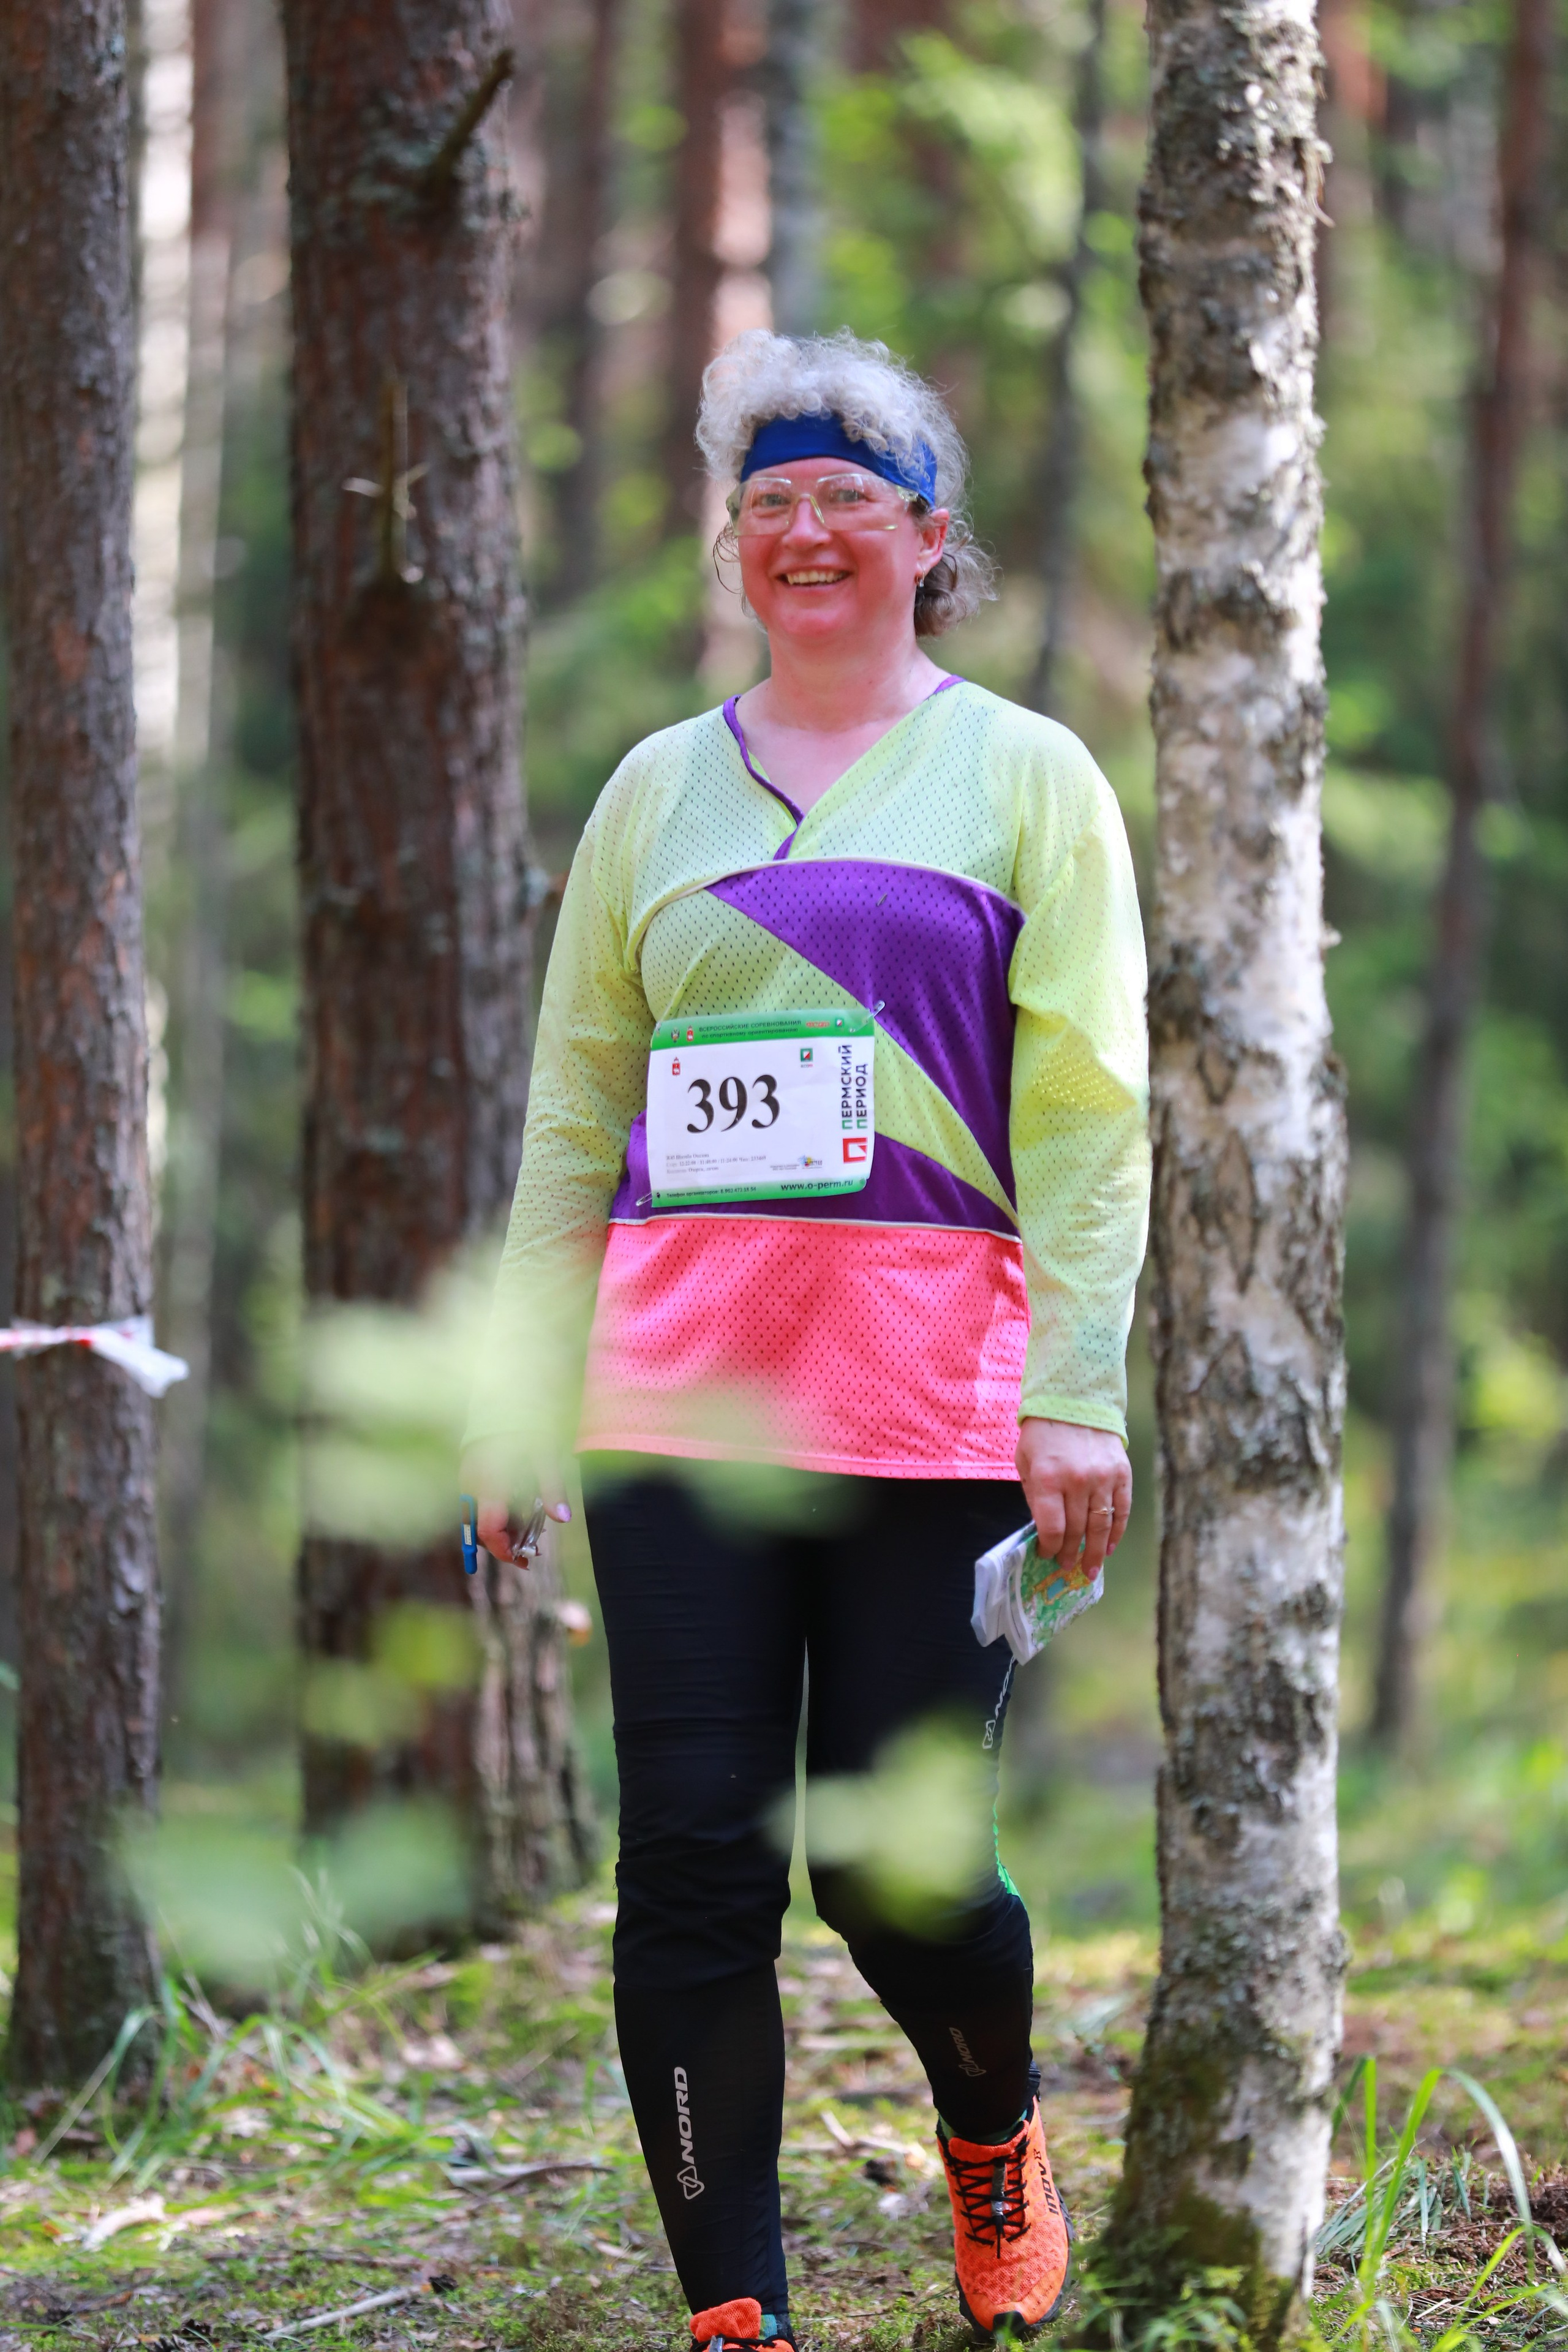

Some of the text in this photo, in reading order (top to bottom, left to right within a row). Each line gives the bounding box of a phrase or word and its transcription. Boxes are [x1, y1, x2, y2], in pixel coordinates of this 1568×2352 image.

[699, 1022, 749, 1032] ВСЕРОССИЙСКИЕ
[750, 1020, 802, 1029] СОРЕВНОВАНИЯ
[687, 1074, 780, 1133] 393
[838, 1045, 853, 1129] ПЕРМСКИЙ
[856, 1064, 868, 1129] ПЕРИОД
[781, 1180, 853, 1191] www.o-perm.ru
[949, 2027, 975, 2064] NORD
[674, 2067, 695, 2165] NORD
